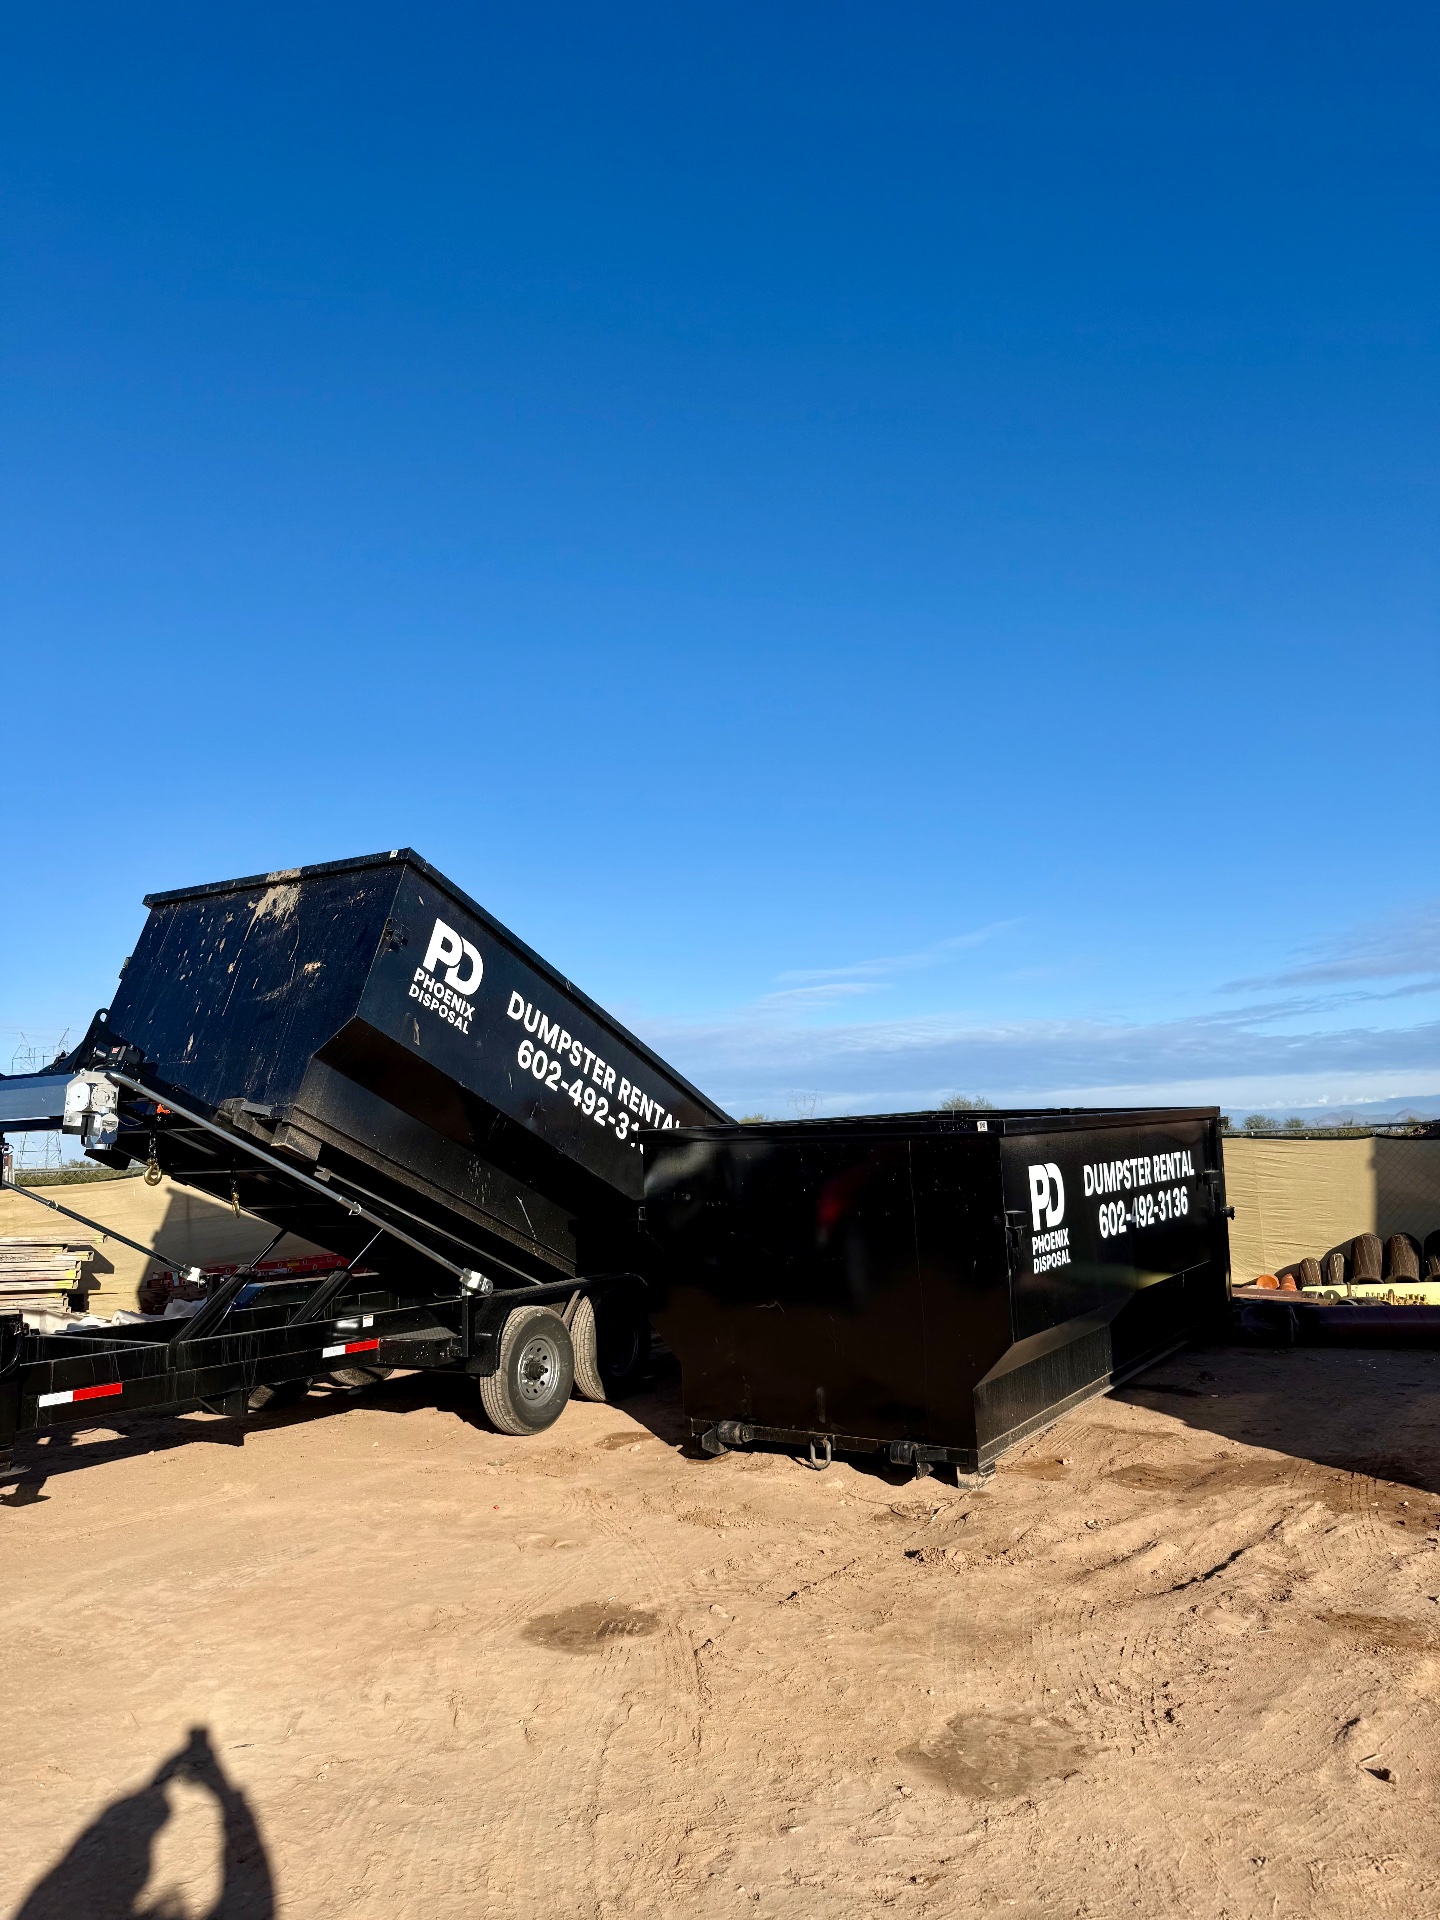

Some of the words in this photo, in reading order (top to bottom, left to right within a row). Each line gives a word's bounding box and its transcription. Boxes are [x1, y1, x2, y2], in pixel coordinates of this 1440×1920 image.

[418, 918, 483, 997] PD
[408, 984, 469, 1035] DISPOSAL
[413, 967, 476, 1021] PHOENIX
[507, 990, 616, 1094] DUMPSTER
[1028, 1163, 1064, 1231] PD
[1083, 1157, 1151, 1196] DUMPSTER
[1153, 1150, 1195, 1182] RENTAL
[1099, 1186, 1189, 1238] 602-492-3136
[1032, 1228, 1070, 1255] PHOENIX
[1033, 1249, 1071, 1274] DISPOSAL
